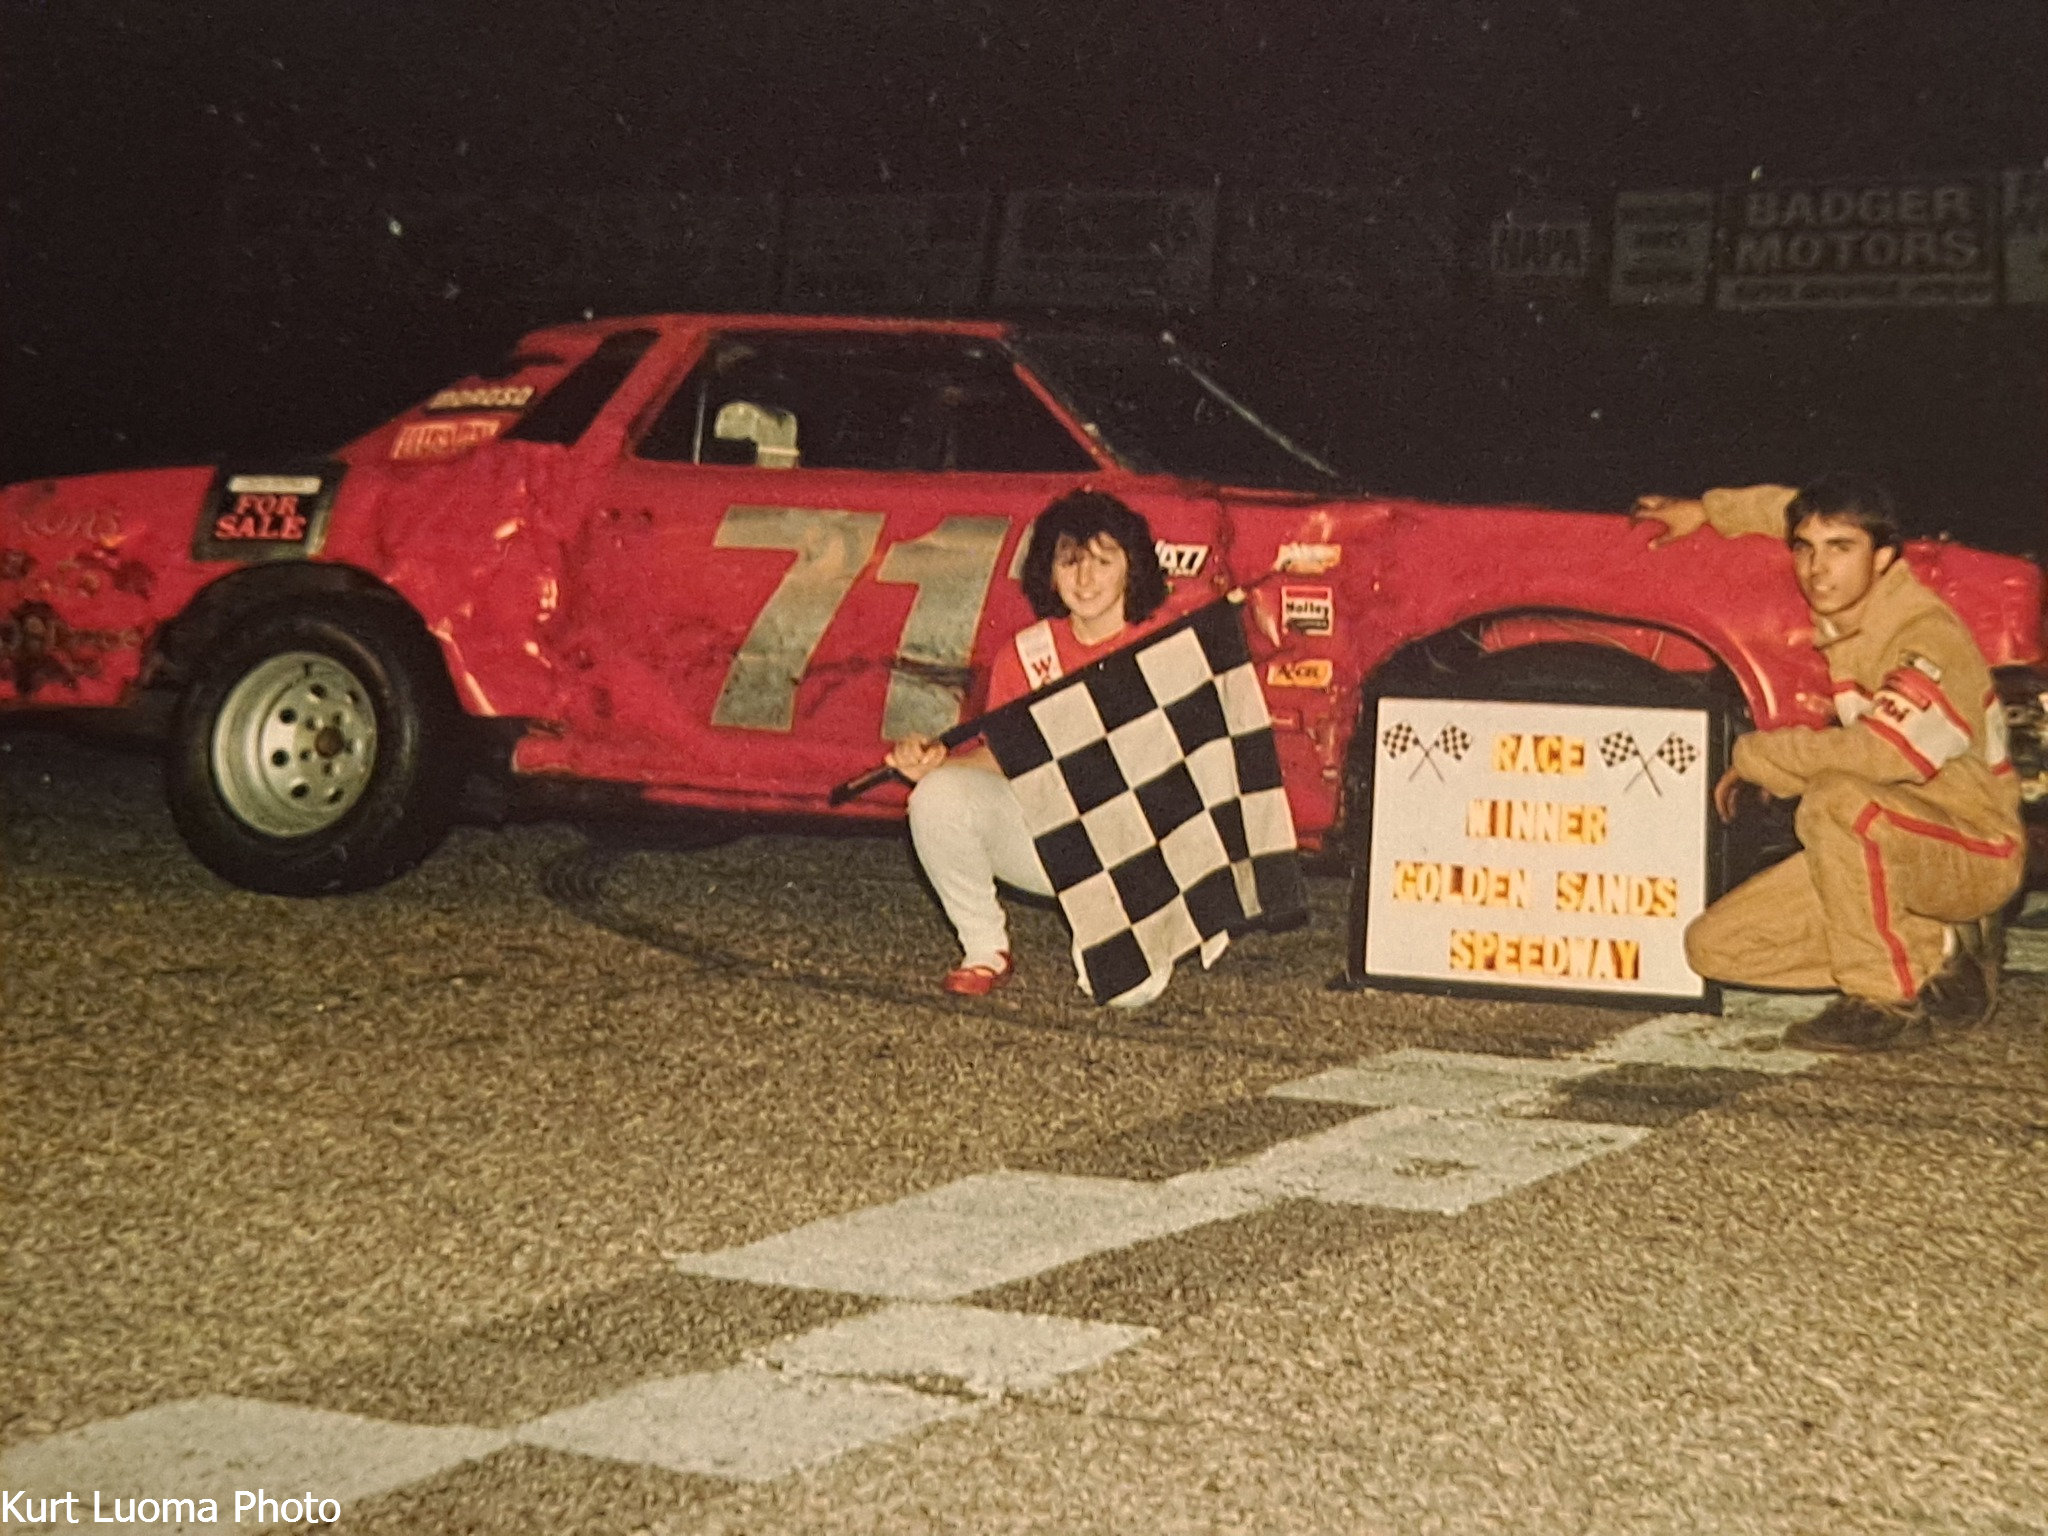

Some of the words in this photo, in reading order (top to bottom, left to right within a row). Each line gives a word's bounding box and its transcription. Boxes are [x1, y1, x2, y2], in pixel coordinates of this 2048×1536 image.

[1746, 186, 1972, 228] BADGER
[1735, 229, 1980, 272] MOTORS
[236, 494, 300, 517] FOR
[215, 514, 307, 541] SALE
[1495, 733, 1587, 776] RACE
[1466, 799, 1608, 844] WINNER
[1393, 860, 1530, 908] GOLDEN
[1556, 870, 1678, 918] SANDS
[1450, 929, 1640, 980] SPEEDWAY
